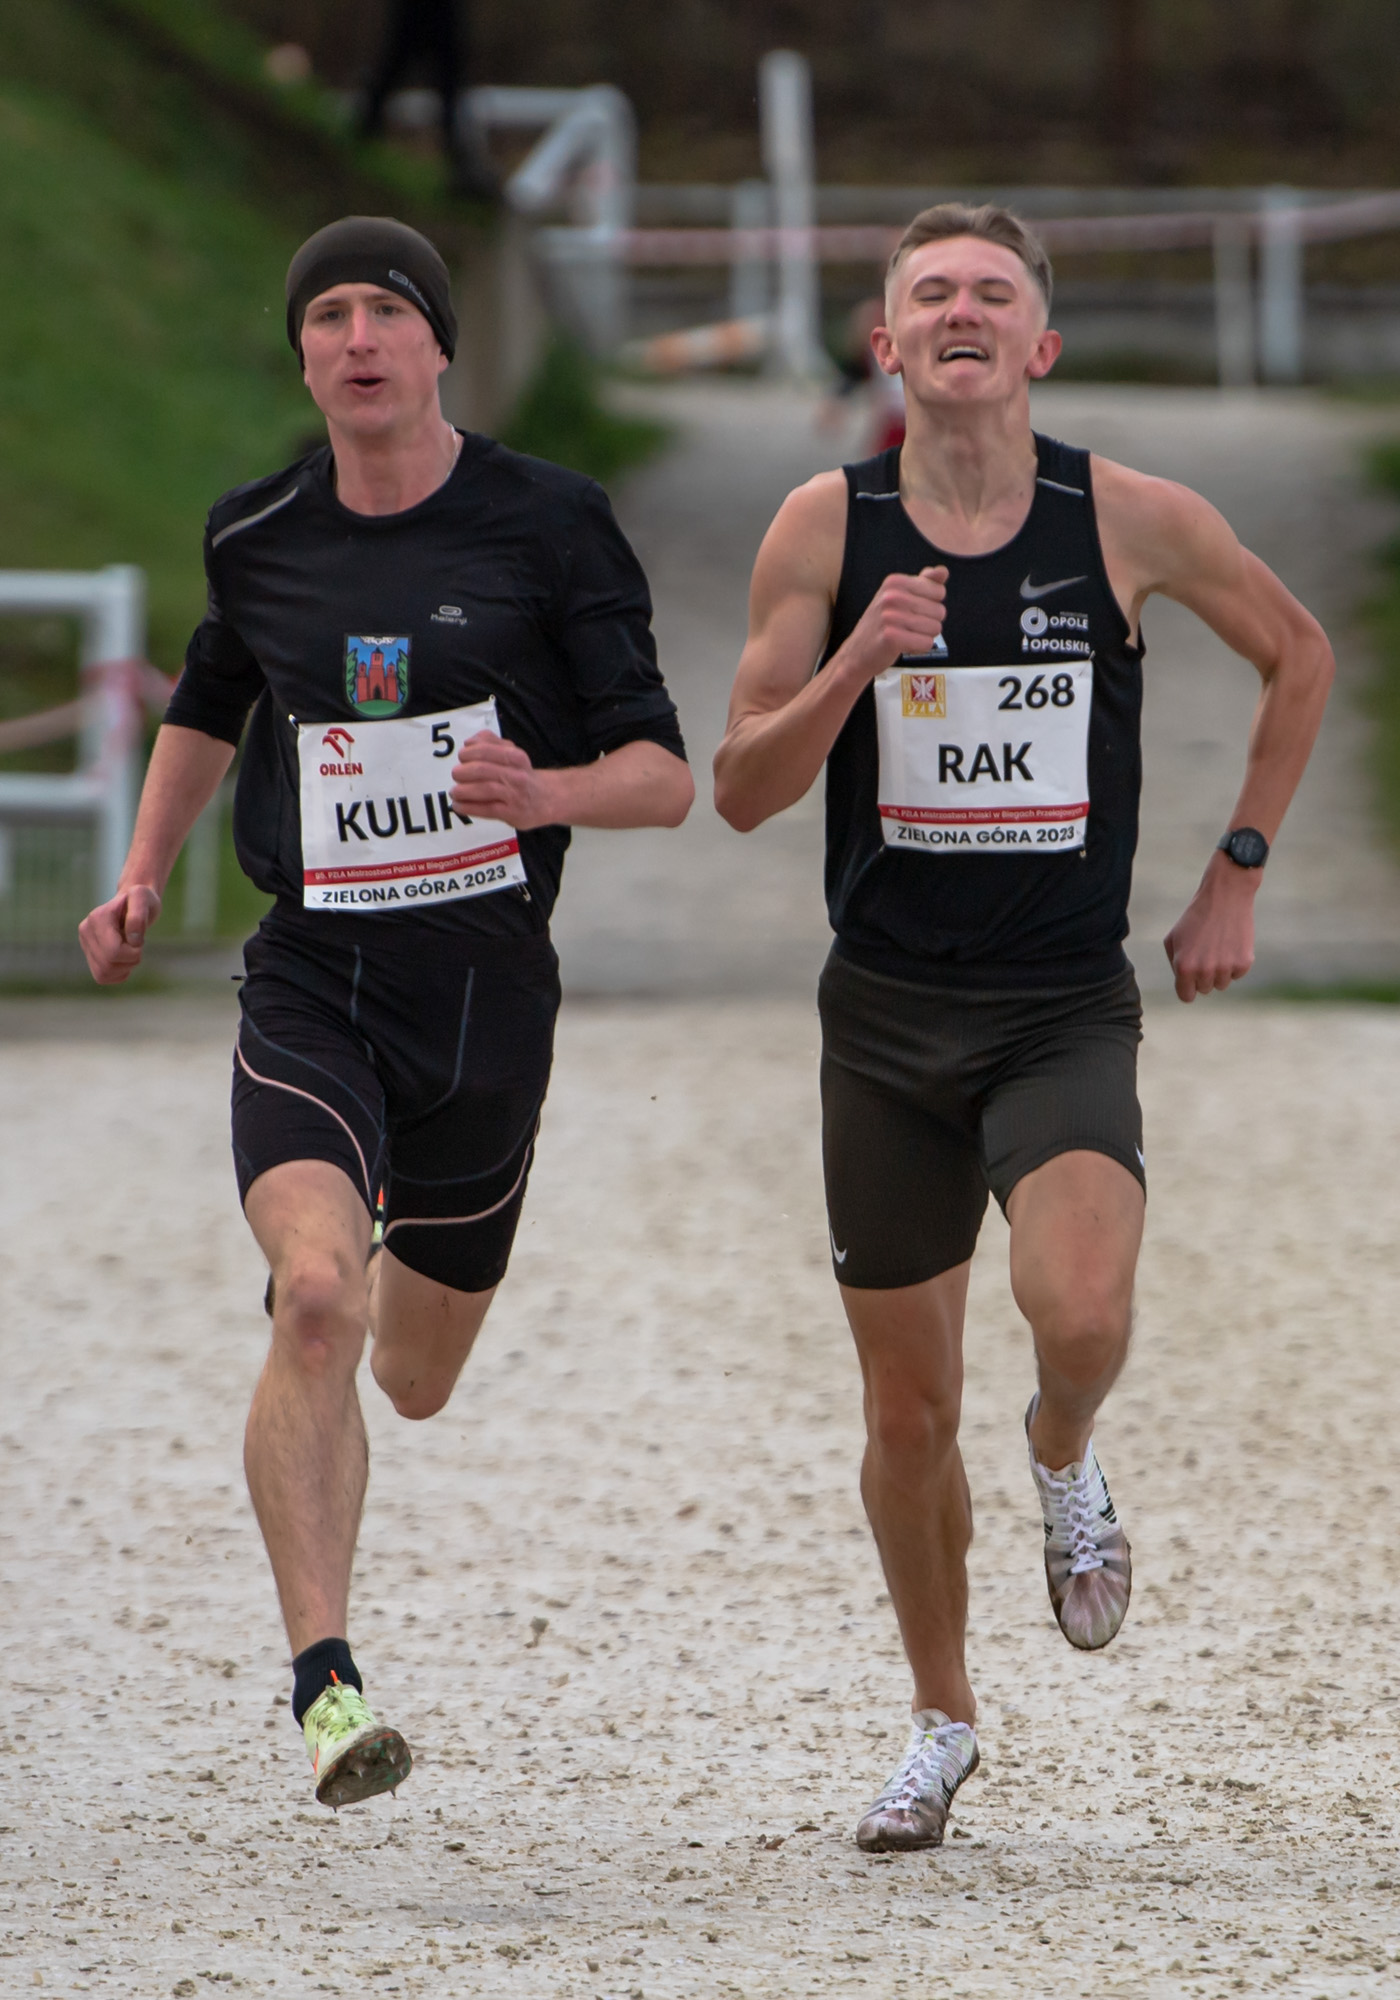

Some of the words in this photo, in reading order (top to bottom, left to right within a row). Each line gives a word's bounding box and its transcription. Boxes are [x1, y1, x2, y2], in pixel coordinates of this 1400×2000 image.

[1049, 616, 1088, 629] OPOLE
[1030, 638, 1090, 654] OPOLSKIE
[998, 672, 1075, 711] 268
[431, 721, 455, 758] 5
[319, 762, 364, 776] ORLEN
[938, 741, 1034, 783] RAK
[968, 810, 991, 819] Polski
[1001, 809, 1035, 820] Biegach
[897, 825, 972, 844] ZIELONA
[976, 825, 1032, 844] GÓRA
[1036, 825, 1075, 843] 2023
[393, 863, 416, 874] Polski
[418, 863, 425, 871] w
[426, 857, 460, 870] Biegach
[322, 886, 401, 904] ZIELONA
[404, 878, 460, 898] GÓRA
[464, 864, 506, 888] 2023
